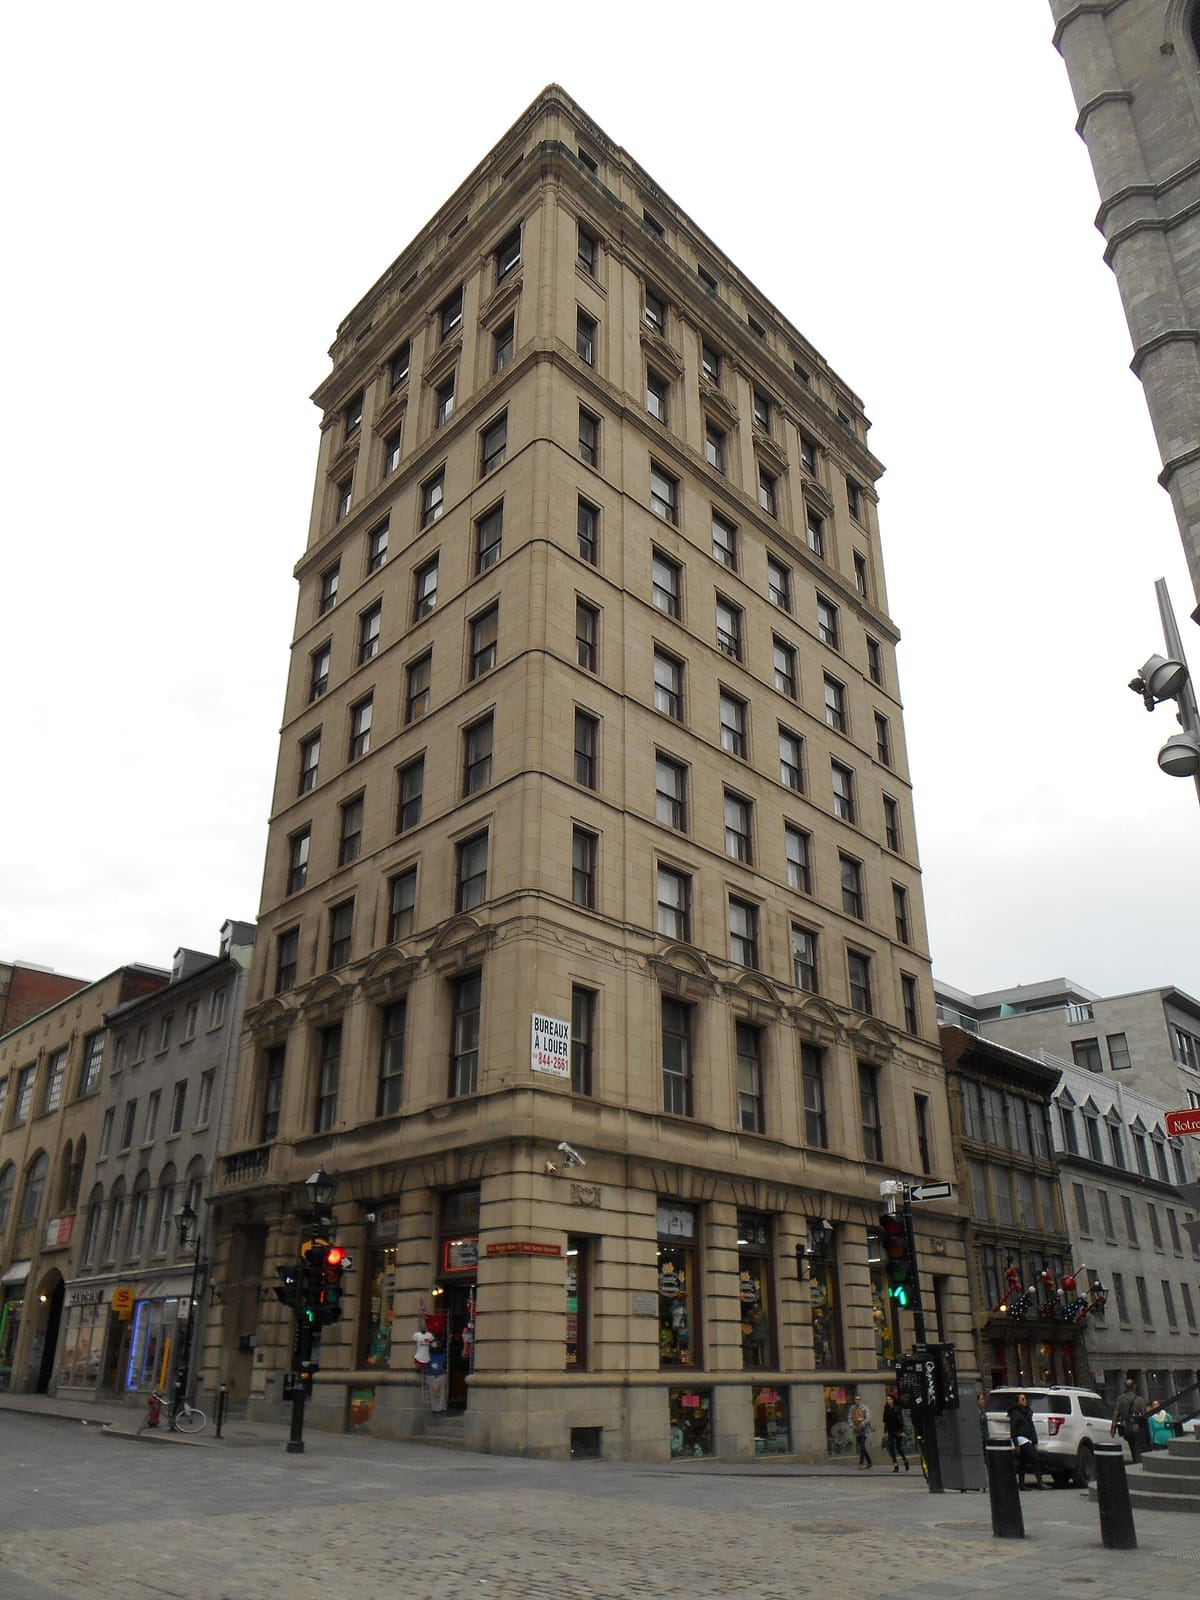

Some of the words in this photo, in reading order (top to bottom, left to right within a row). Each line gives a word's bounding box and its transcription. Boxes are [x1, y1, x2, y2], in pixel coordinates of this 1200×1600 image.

[534, 1017, 569, 1040] BUREAUX
[534, 1032, 539, 1049] À
[543, 1037, 568, 1057] LOUER
